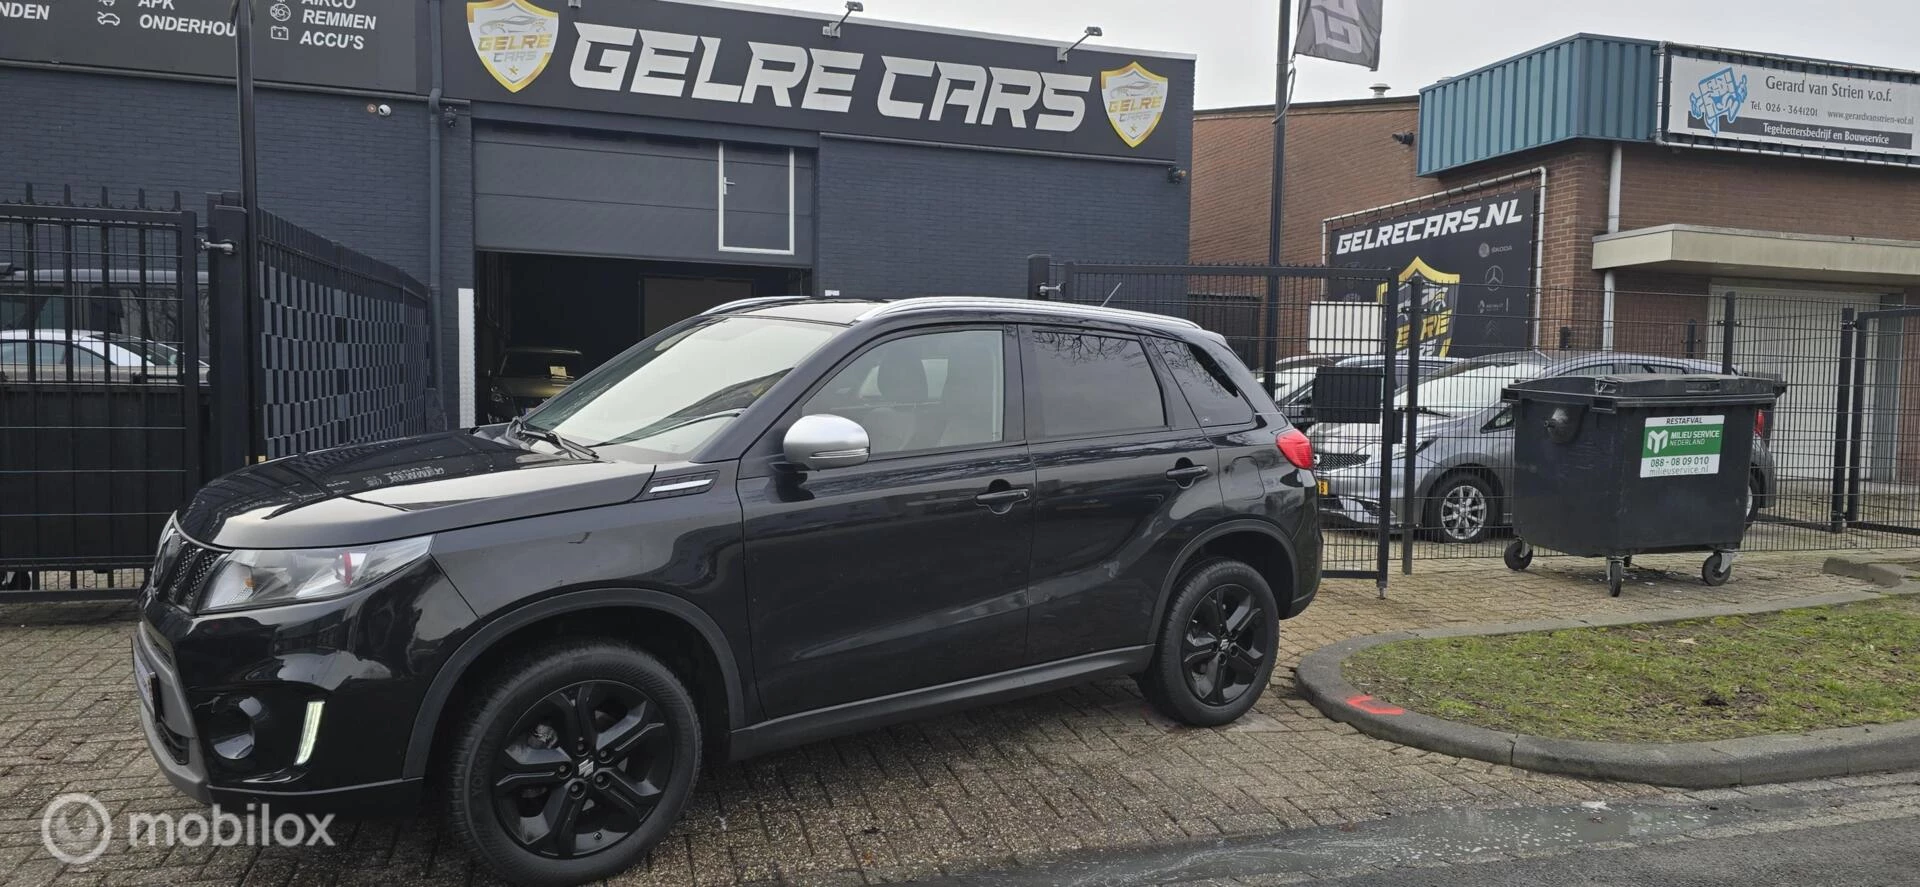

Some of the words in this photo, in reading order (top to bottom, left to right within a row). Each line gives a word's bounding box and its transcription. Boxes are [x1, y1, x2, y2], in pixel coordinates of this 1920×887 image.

[139, 14, 236, 37] ONDERHOU
[302, 9, 377, 31] REMMEN
[299, 30, 365, 51] ACCU'S
[478, 34, 553, 51] GELRE
[493, 51, 537, 63] CARS
[569, 22, 864, 113] GELRE
[877, 55, 1093, 132] CARS
[1765, 75, 1805, 93] Gerard
[1808, 84, 1828, 96] van
[1831, 83, 1864, 99] Strien
[1867, 88, 1893, 102] v.o.f.
[1108, 96, 1163, 113] GELRE
[1750, 100, 1762, 111] Tel.
[1765, 102, 1781, 113] 026
[1827, 111, 1914, 125] www.gerardvanstrien-vof.nl
[1762, 121, 1832, 141] Tegelzettersbedrijf
[1833, 131, 1843, 141] en
[1844, 130, 1890, 145] Bouwservice
[1336, 198, 1523, 255] GELRECARS.NL
[1670, 431, 1693, 439] MILIEU
[1693, 430, 1720, 438] SERVICE
[1650, 459, 1664, 467] 088
[1671, 457, 1680, 466] 08
[1682, 457, 1692, 465] 09
[1694, 456, 1709, 465] 010
[1649, 466, 1709, 475] milieuservice.nl
